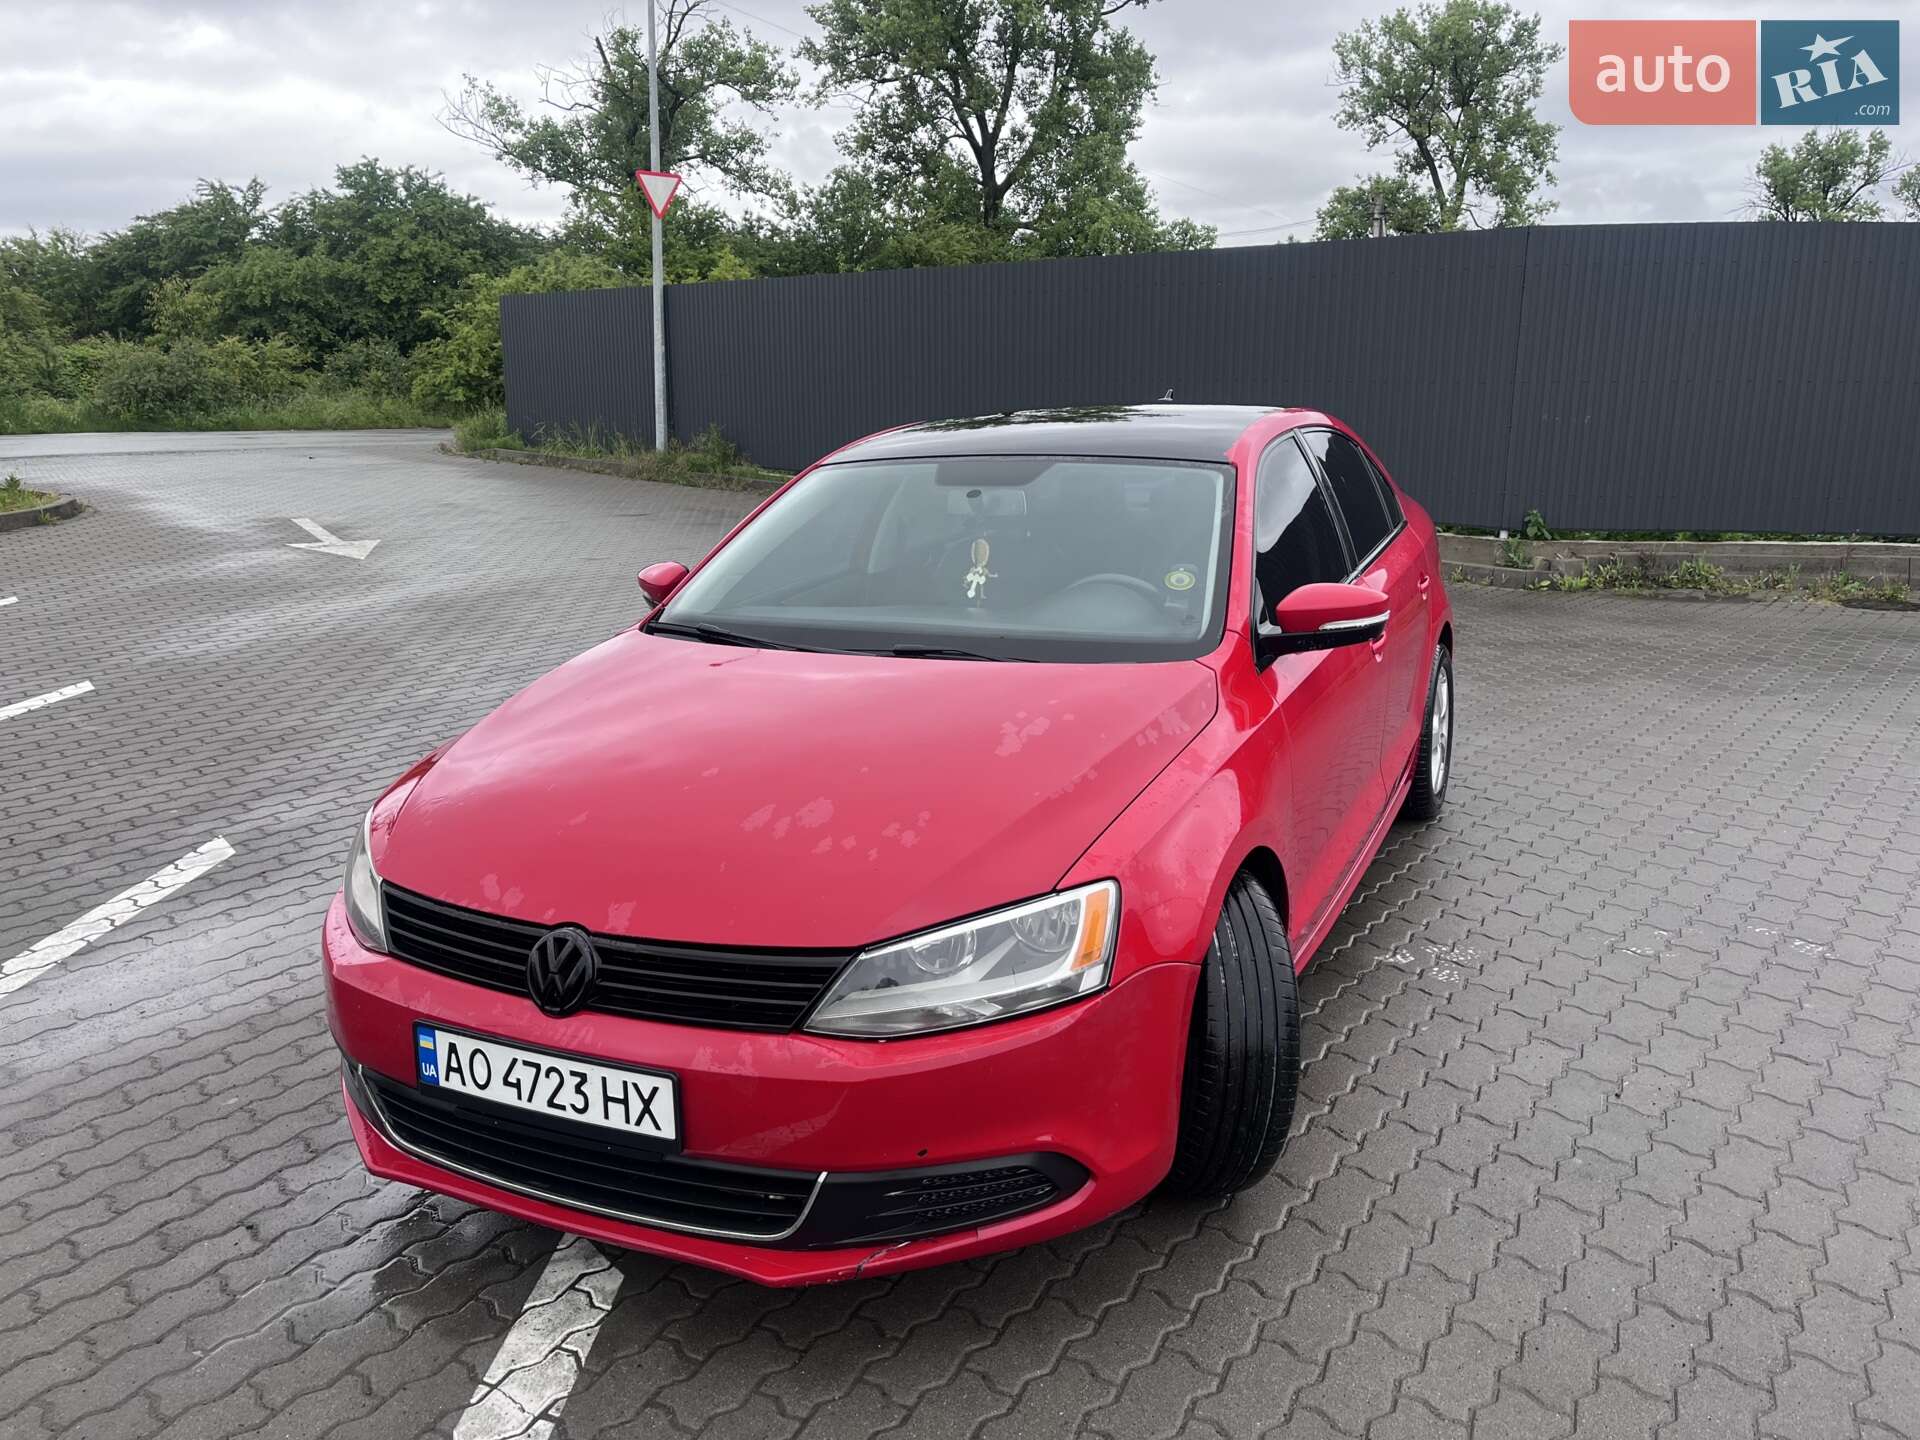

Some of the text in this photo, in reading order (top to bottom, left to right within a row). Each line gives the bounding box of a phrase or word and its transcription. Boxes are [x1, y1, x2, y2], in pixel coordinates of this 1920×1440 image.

[421, 1061, 438, 1078] UA
[444, 1041, 662, 1131] AO 4723 HX
